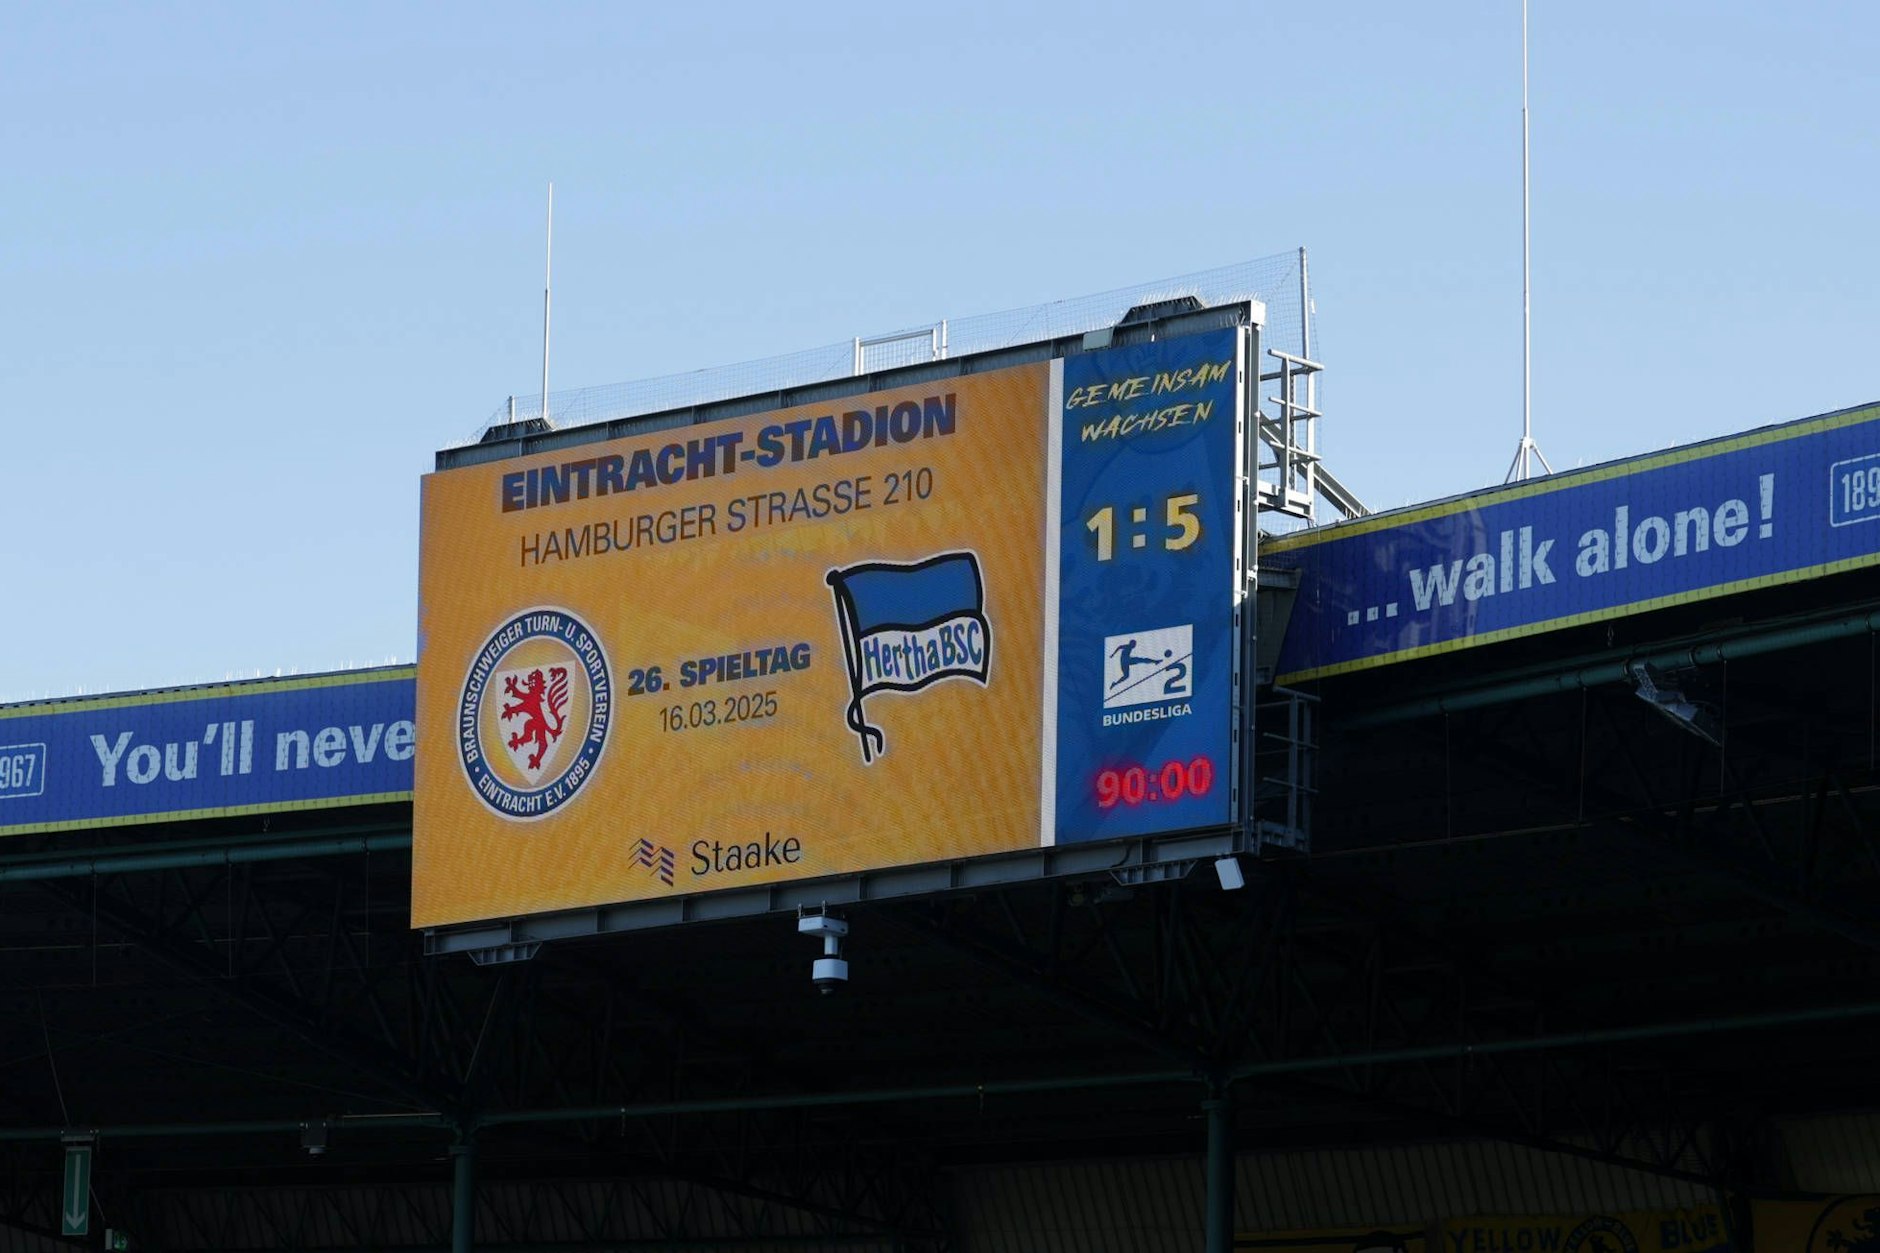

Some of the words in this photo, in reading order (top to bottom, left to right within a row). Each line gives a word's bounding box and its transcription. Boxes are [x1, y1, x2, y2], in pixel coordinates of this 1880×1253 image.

[1065, 360, 1232, 410] GEMEINSAM
[1081, 400, 1213, 443] WACHSEN
[501, 392, 957, 514] EINTRACHT-STADION
[520, 504, 717, 567] HAMBURGER
[726, 475, 872, 533] STRASSE
[883, 466, 934, 504] 210
[1575, 472, 1775, 579] alone!
[463, 621, 525, 764] BRAUNSCHWEIGER
[524, 614, 563, 634] TURN-
[564, 624, 575, 642] U.
[575, 634, 608, 743] SPORTVEREIN
[627, 666, 670, 696] 26.
[679, 642, 812, 689] SPIELTAG
[1163, 662, 1187, 695] 2
[659, 690, 778, 733] 16.03.2025
[1102, 703, 1193, 727] BUNDESLIGA
[89, 719, 255, 788] You'll
[478, 773, 543, 813] EINTRACHT
[545, 788, 567, 808] E.V.
[565, 758, 591, 790] 1895
[1096, 756, 1213, 809] 90:00
[690, 831, 801, 876] Staake
